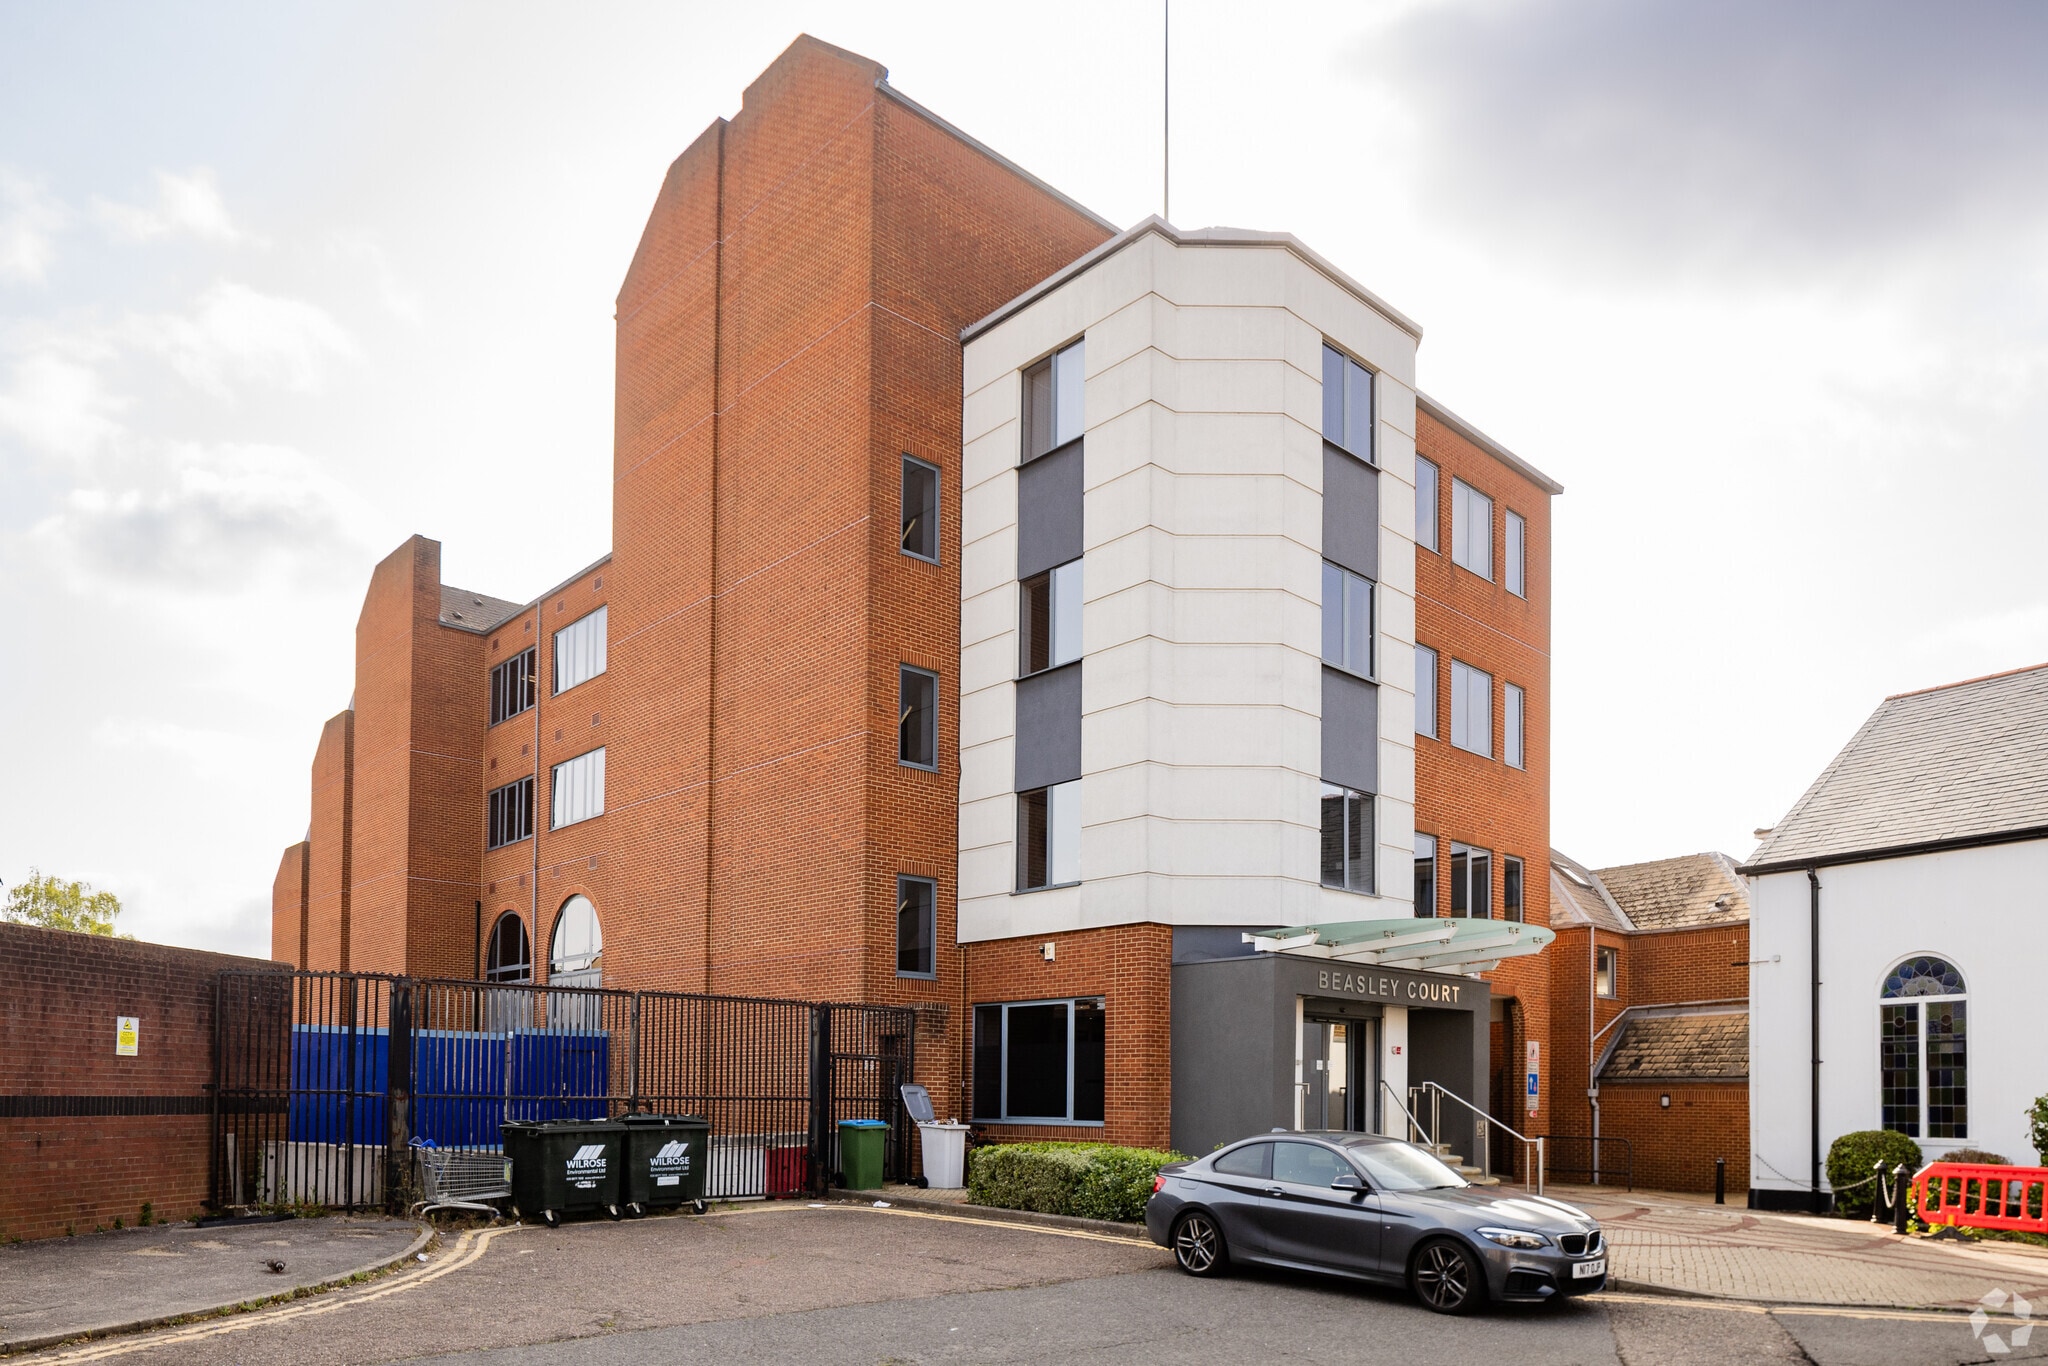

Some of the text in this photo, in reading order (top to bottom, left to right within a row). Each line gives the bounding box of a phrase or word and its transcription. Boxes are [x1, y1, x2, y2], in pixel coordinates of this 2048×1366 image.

[1319, 970, 1460, 1003] BEASLEY COURT
[566, 1158, 607, 1169] WILROSE
[650, 1156, 690, 1166] WILROSE
